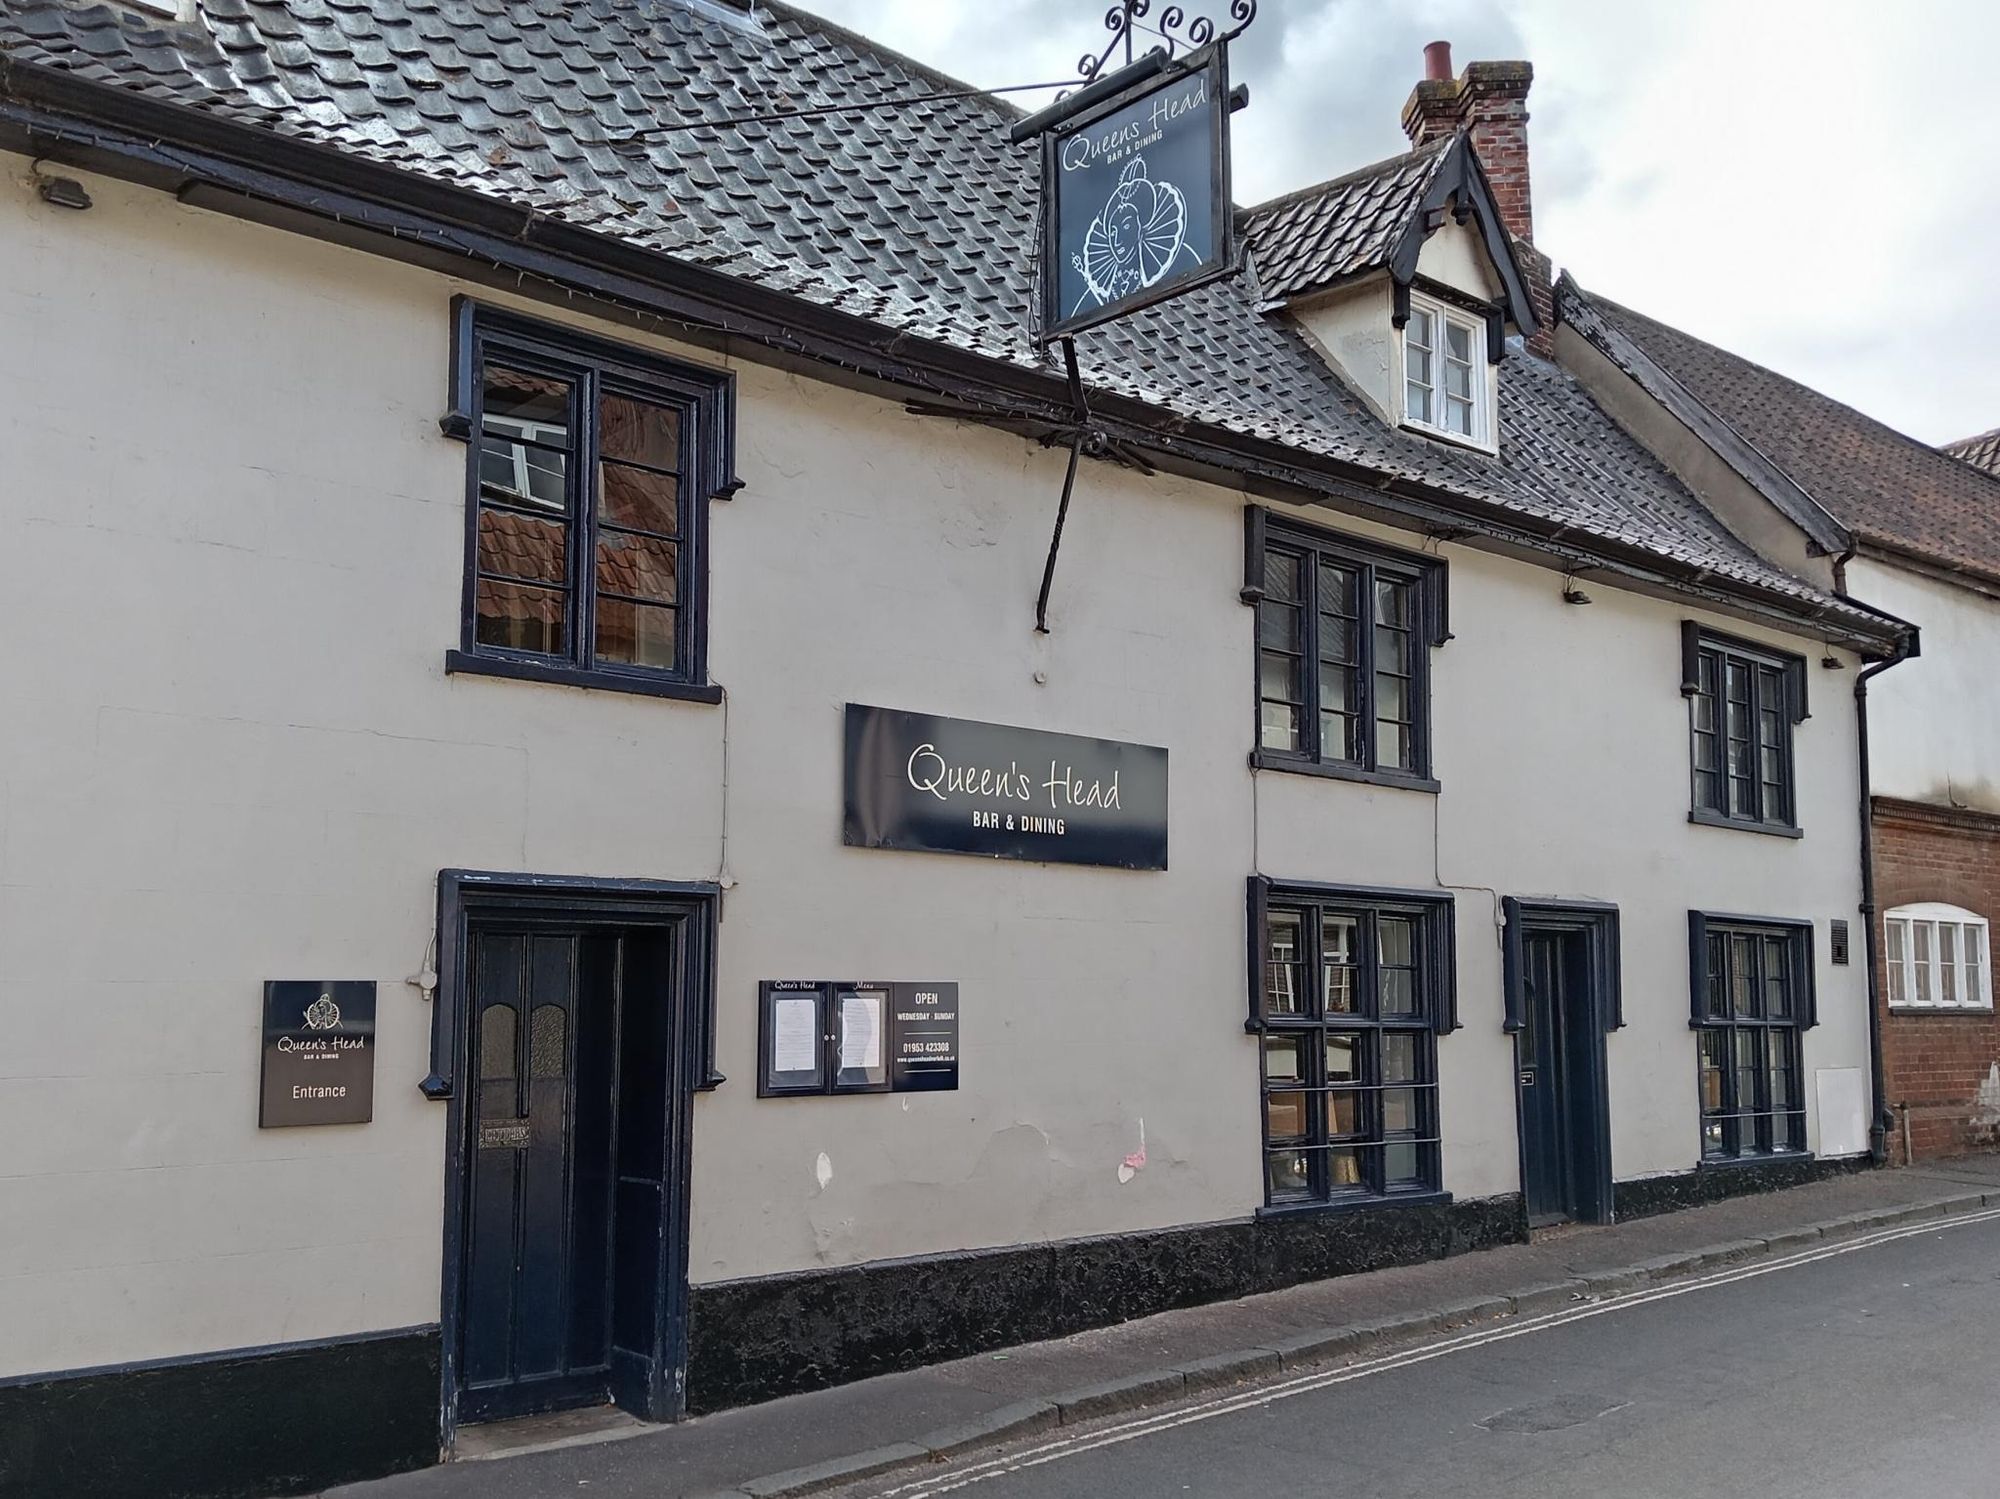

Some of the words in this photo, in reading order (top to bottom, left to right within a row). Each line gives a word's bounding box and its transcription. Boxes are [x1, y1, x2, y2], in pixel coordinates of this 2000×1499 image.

[1062, 122, 1140, 172] Queens
[1147, 79, 1207, 131] Head
[1106, 150, 1123, 165] BAR
[1125, 145, 1132, 155] &
[1134, 129, 1164, 151] DINING
[907, 743, 1031, 801] Queen's
[1041, 760, 1121, 810] Head
[973, 811, 1000, 829] BAR
[1005, 815, 1015, 831] &
[1020, 815, 1065, 835] DINING
[799, 980, 816, 990] Head
[915, 992, 938, 1005] OPEN
[897, 1012, 930, 1021] WEDNESDAY
[934, 1012, 955, 1020] SUNDAY
[277, 1036, 327, 1053] Queen's
[331, 1035, 365, 1051] Head
[903, 1042, 924, 1053] 01953
[292, 1085, 346, 1099] Entrance
